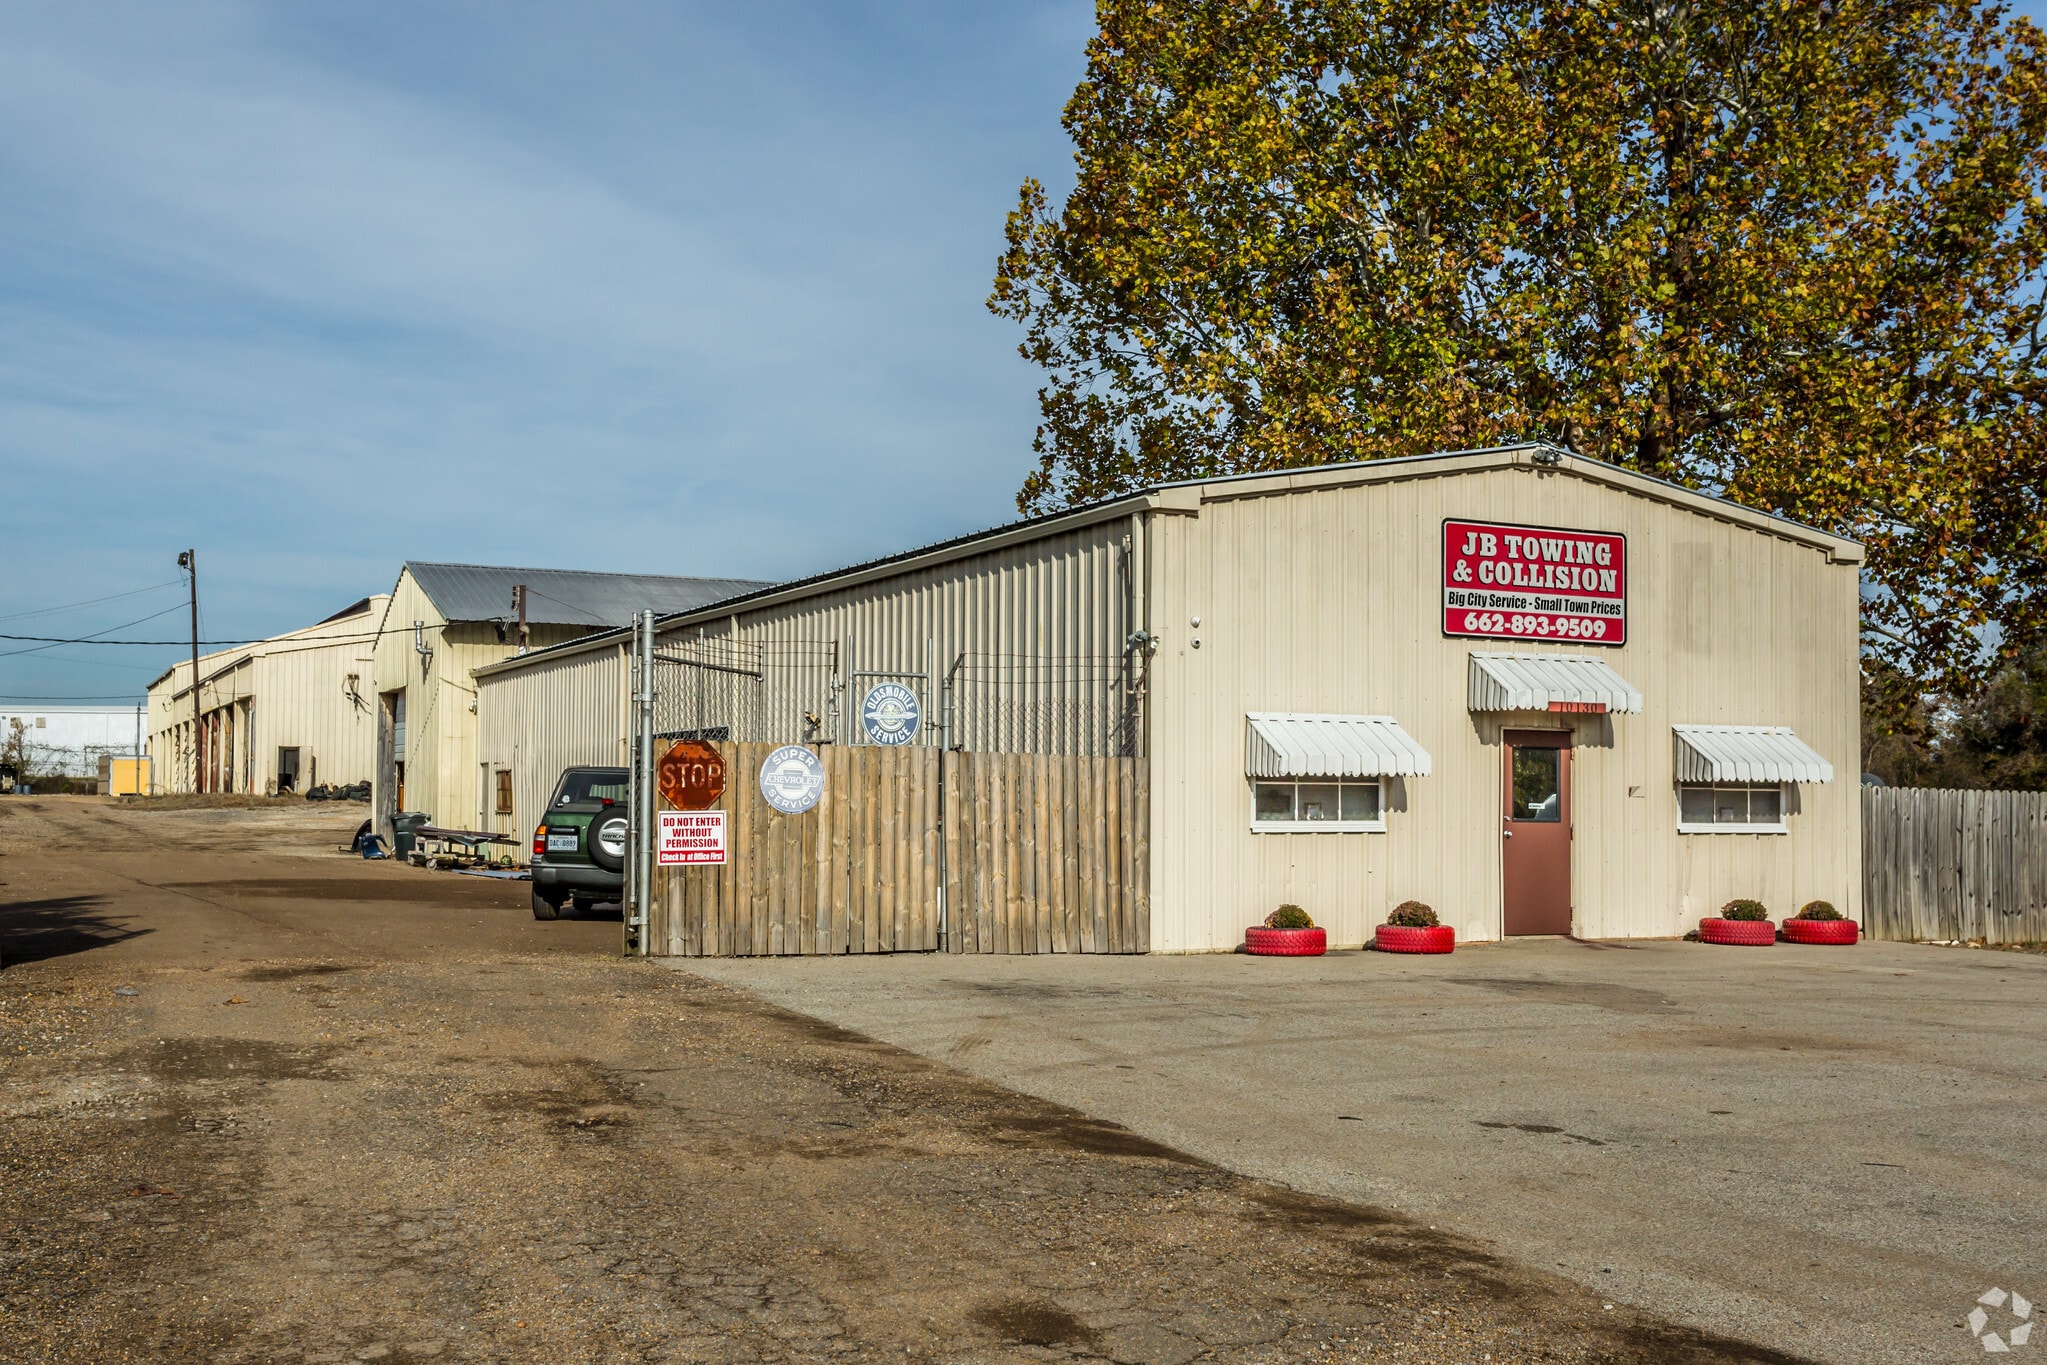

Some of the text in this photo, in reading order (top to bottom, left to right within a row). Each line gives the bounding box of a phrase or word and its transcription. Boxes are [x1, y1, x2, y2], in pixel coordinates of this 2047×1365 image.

[1461, 532, 1612, 566] JB TOWING
[1452, 559, 1618, 593] & COLLISION
[1448, 591, 1465, 607] Big
[1467, 592, 1487, 608] City
[1489, 594, 1527, 609] Service
[1534, 596, 1562, 612] Small
[1564, 598, 1589, 614] Town
[1591, 600, 1621, 615] Prices
[1464, 611, 1607, 639] 662-893-9509
[866, 685, 915, 711] OLDSMOBILE
[1560, 702, 1598, 714] 10130
[870, 725, 911, 744] SERVICE
[772, 749, 815, 767] SUPER
[662, 763, 721, 789] STOP
[768, 775, 818, 785] CHEVROLET
[768, 789, 816, 809] SERVICE
[663, 817, 721, 827] DO NOT ENTER
[672, 828, 712, 837] WITHOUT
[666, 838, 718, 848] PERMISSION
[661, 852, 679, 862] Check
[694, 852, 710, 861] Office
[710, 852, 723, 861] First
